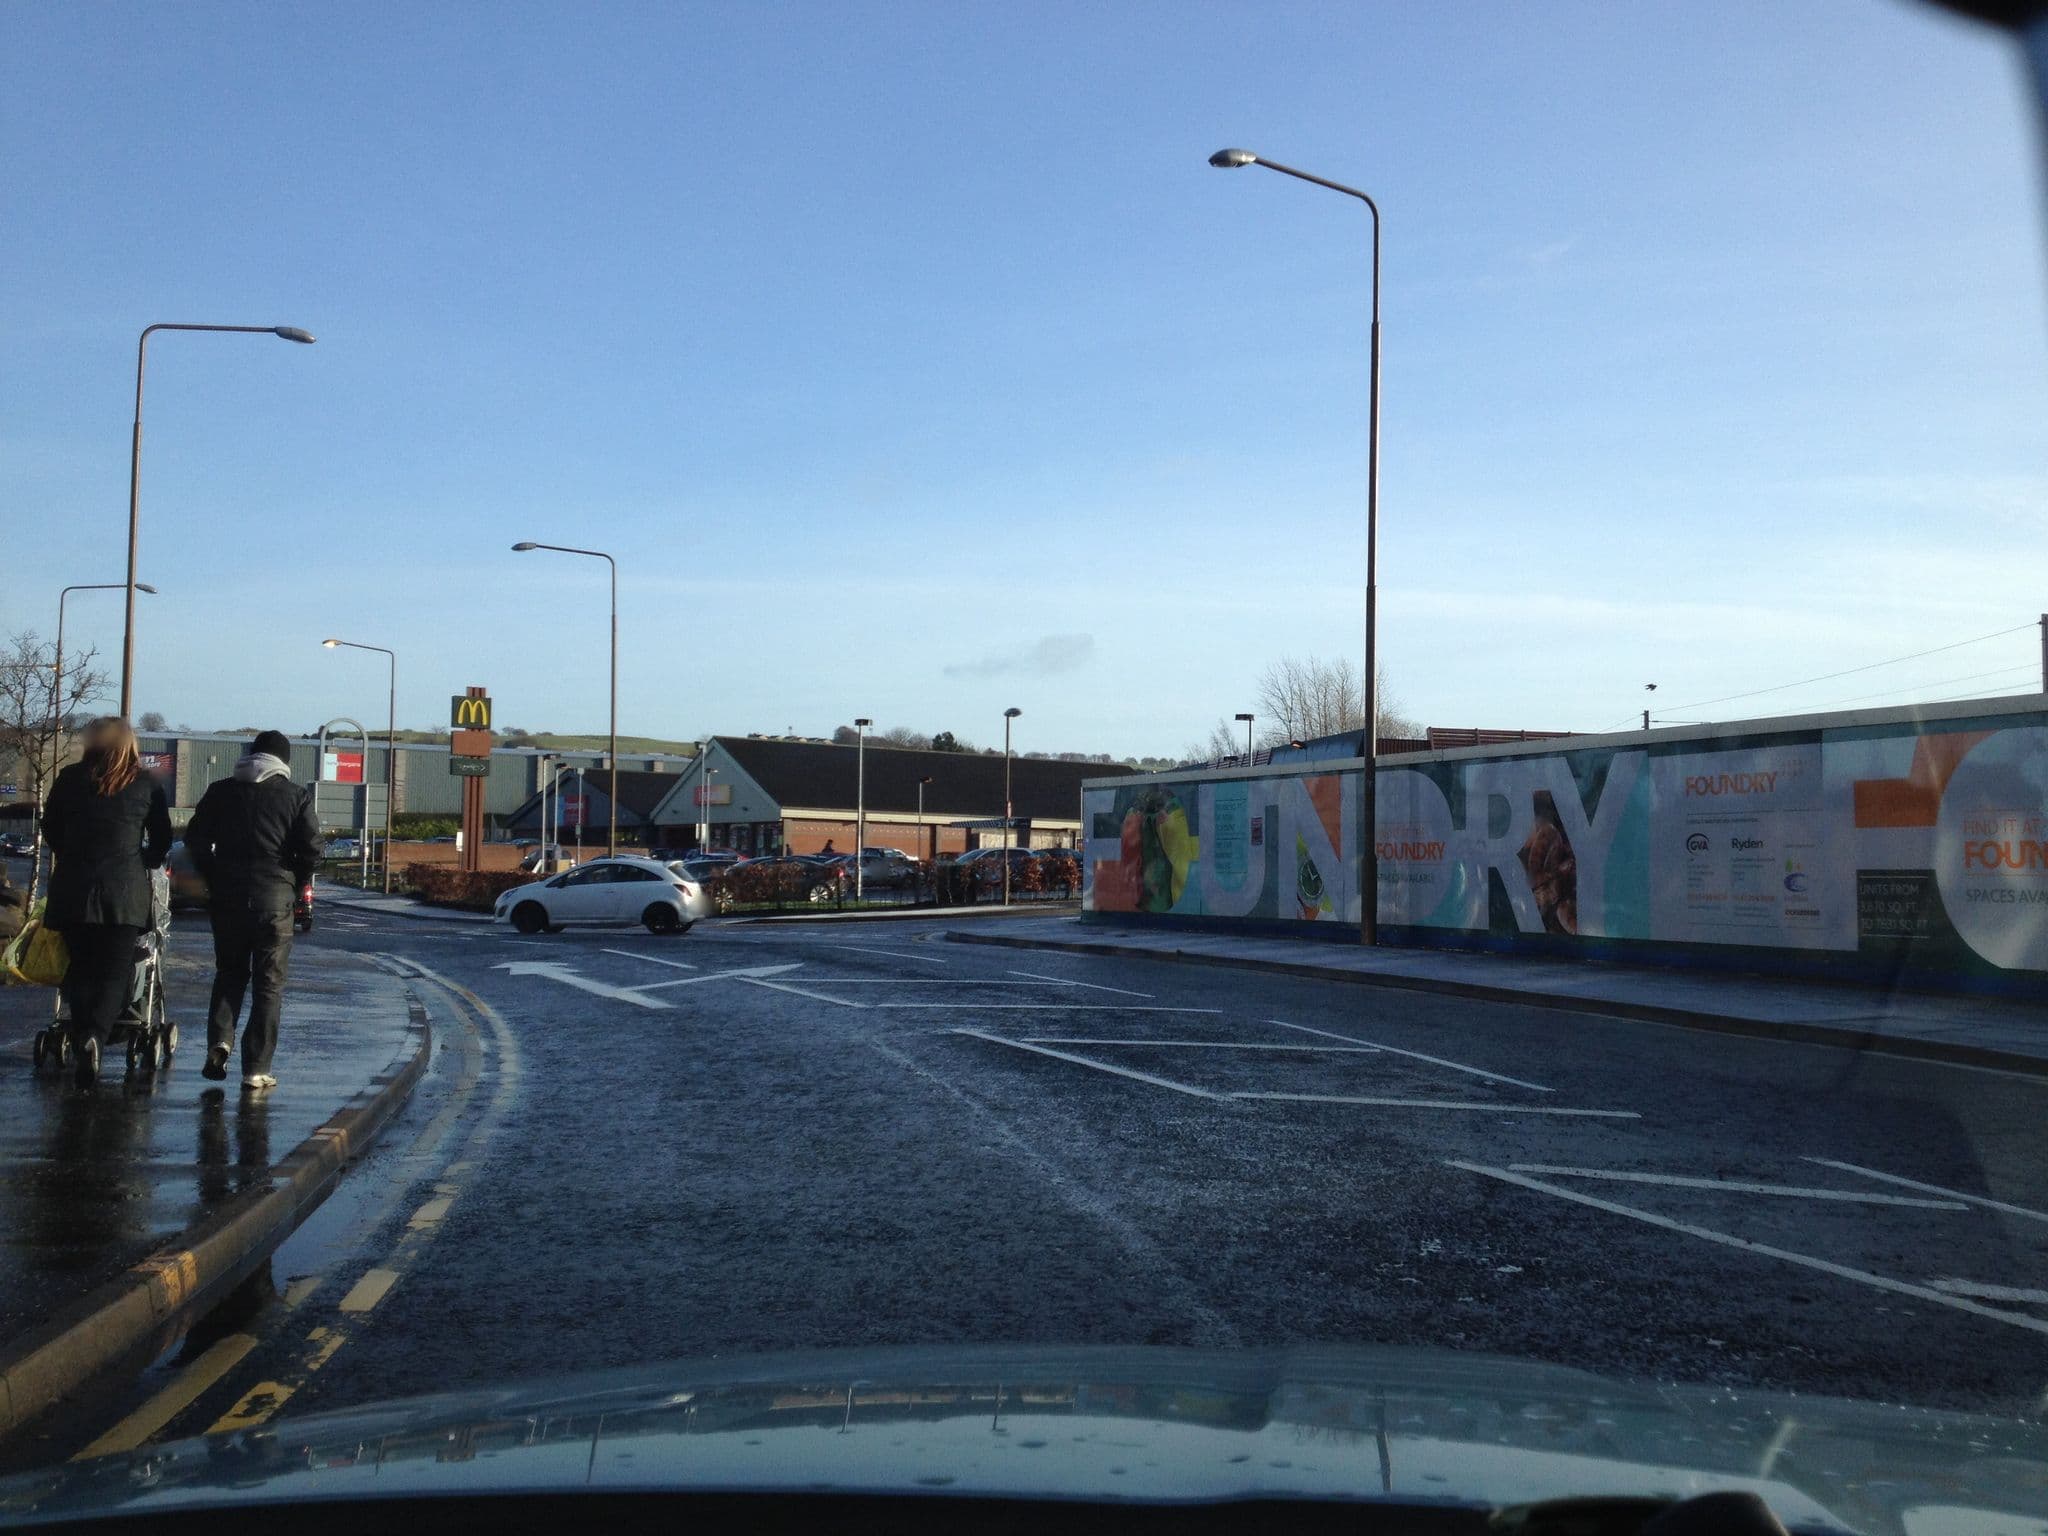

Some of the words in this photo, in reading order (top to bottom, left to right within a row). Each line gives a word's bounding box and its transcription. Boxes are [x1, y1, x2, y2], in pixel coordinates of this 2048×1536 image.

[1685, 771, 1777, 797] FOUNDRY
[1376, 841, 1447, 860] FOUNDRY
[1690, 840, 1709, 852] GVA
[1731, 837, 1764, 852] Ryden
[1860, 884, 1888, 896] UNITS
[1890, 884, 1920, 896] FROM
[1966, 888, 2015, 905] SPACES
